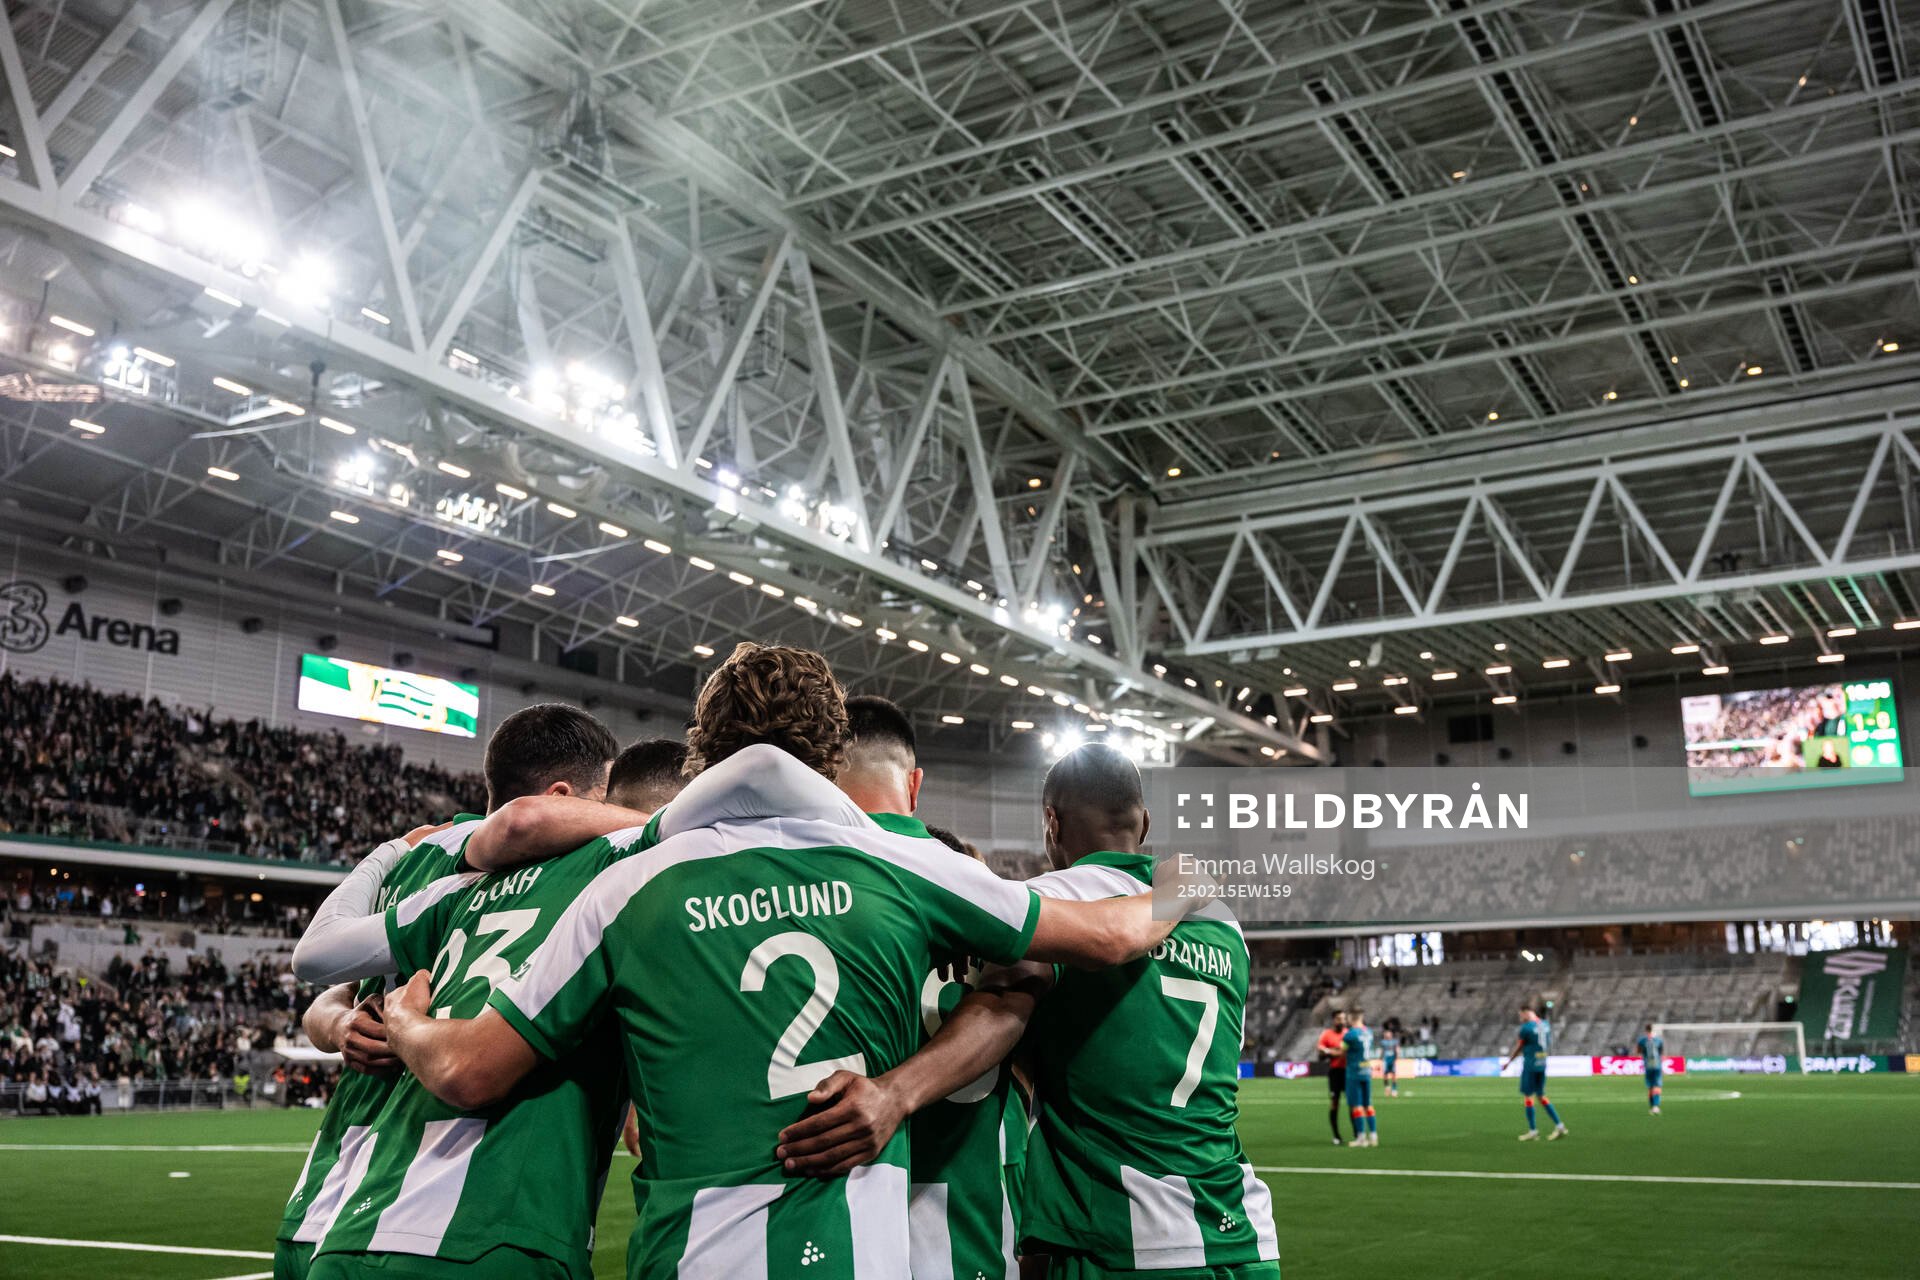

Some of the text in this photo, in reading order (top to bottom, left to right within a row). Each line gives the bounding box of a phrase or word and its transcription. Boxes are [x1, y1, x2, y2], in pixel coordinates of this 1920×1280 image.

[56, 602, 180, 656] Arena
[685, 880, 853, 932] SKOGLUND
[1147, 937, 1233, 981] BRAHAM
[740, 931, 868, 1101] 2
[1160, 975, 1220, 1109] 7
